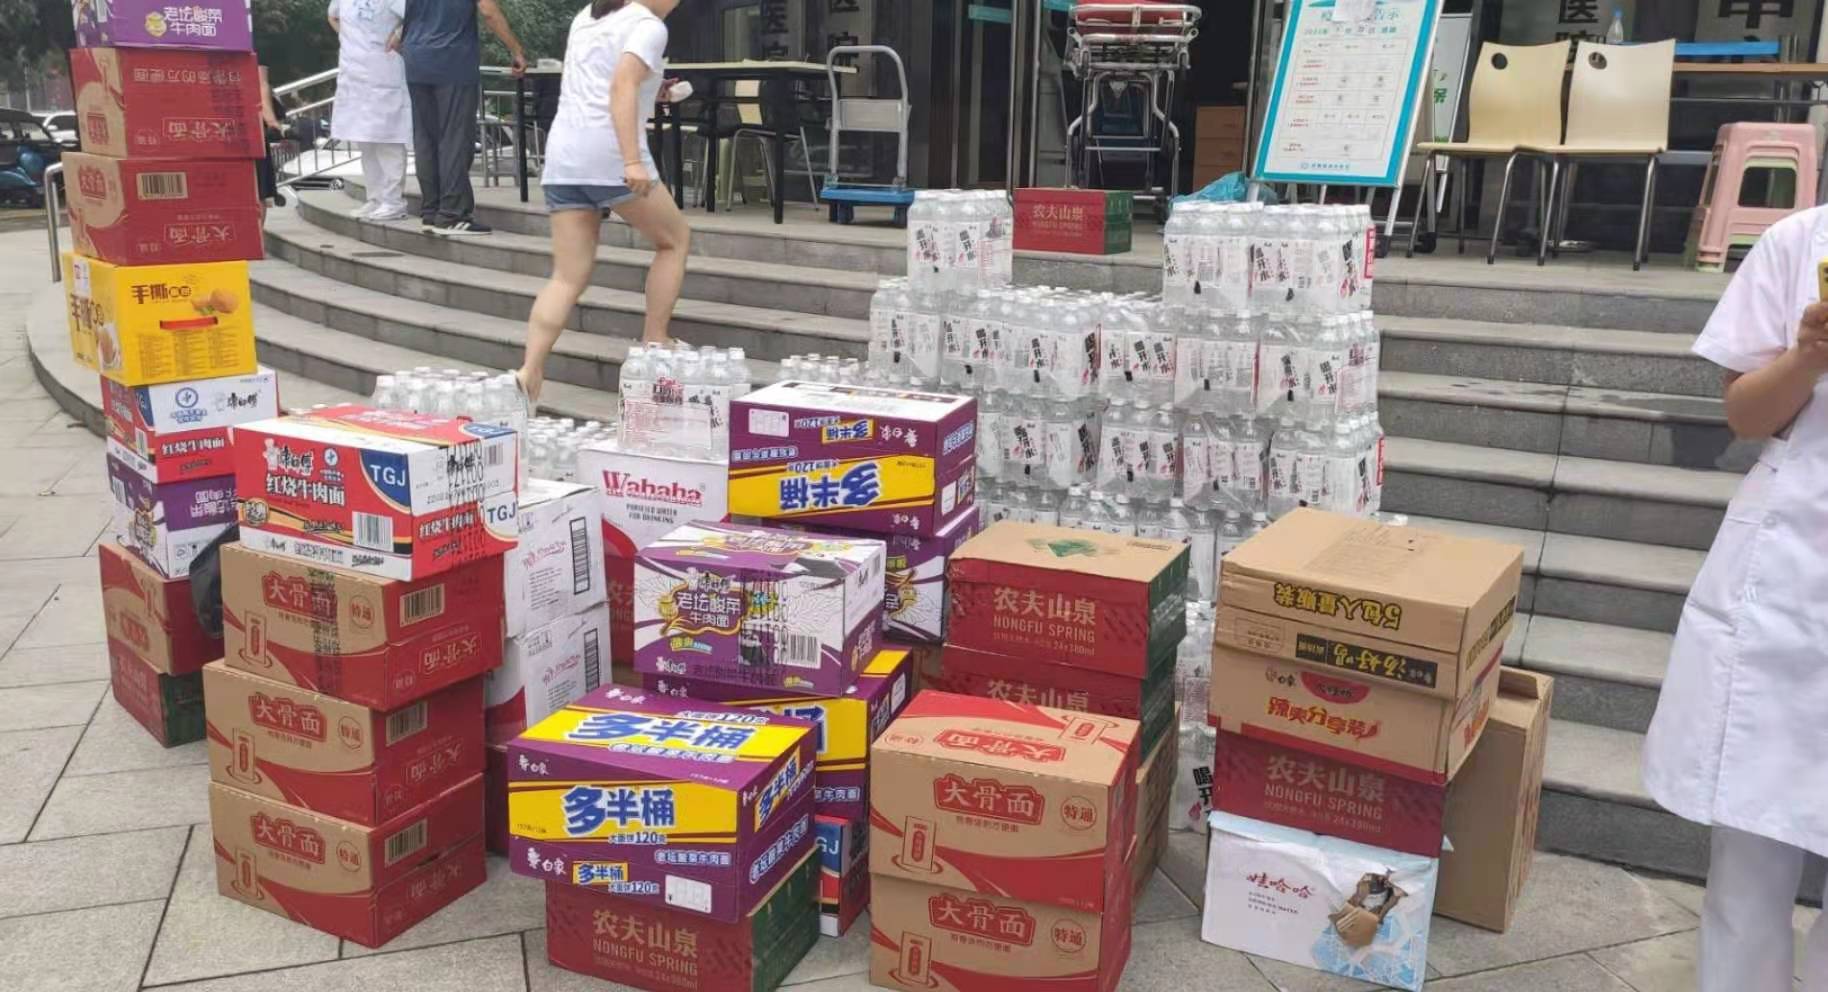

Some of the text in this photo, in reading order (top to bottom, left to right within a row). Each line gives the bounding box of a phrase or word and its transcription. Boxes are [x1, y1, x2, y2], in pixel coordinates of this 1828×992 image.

[170, 22, 217, 37] 牛肉面
[168, 118, 238, 141] 大骨面
[1032, 204, 1084, 221] 农夫山泉
[168, 223, 232, 245] 大骨面
[161, 437, 225, 456] 红烧牛肉面
[826, 419, 869, 440] 多半桶
[265, 474, 346, 506] 红烧牛肉面
[370, 464, 407, 488] TGJ
[603, 469, 702, 499] Wahaha
[778, 462, 880, 511] 多半桶
[486, 502, 517, 523] TGJ
[269, 577, 332, 617] 大骨面
[993, 586, 1096, 626] 农夫山泉
[689, 611, 729, 628] 牛肉面
[993, 615, 1044, 634] NONGFU
[1048, 624, 1096, 643] SPRING
[1333, 643, 1406, 679] 汤好喝
[256, 697, 320, 736] 大骨面
[566, 713, 757, 750] 多半桶
[948, 733, 1053, 760] 大骨面
[758, 755, 800, 828] 多半桶
[1266, 754, 1385, 803] 农夫山泉
[562, 786, 676, 835] 多半桶
[944, 782, 1035, 818] 大骨面
[1264, 783, 1322, 808] NONGFU
[1327, 796, 1383, 821] SPRING
[257, 820, 319, 858] 大骨面
[576, 864, 624, 883] 多半桶
[592, 908, 699, 959] 农夫山泉
[938, 901, 1026, 938] 大骨面
[1054, 929, 1083, 944] 特通
[592, 936, 645, 963] NONGFU
[648, 953, 699, 977] SPRING
